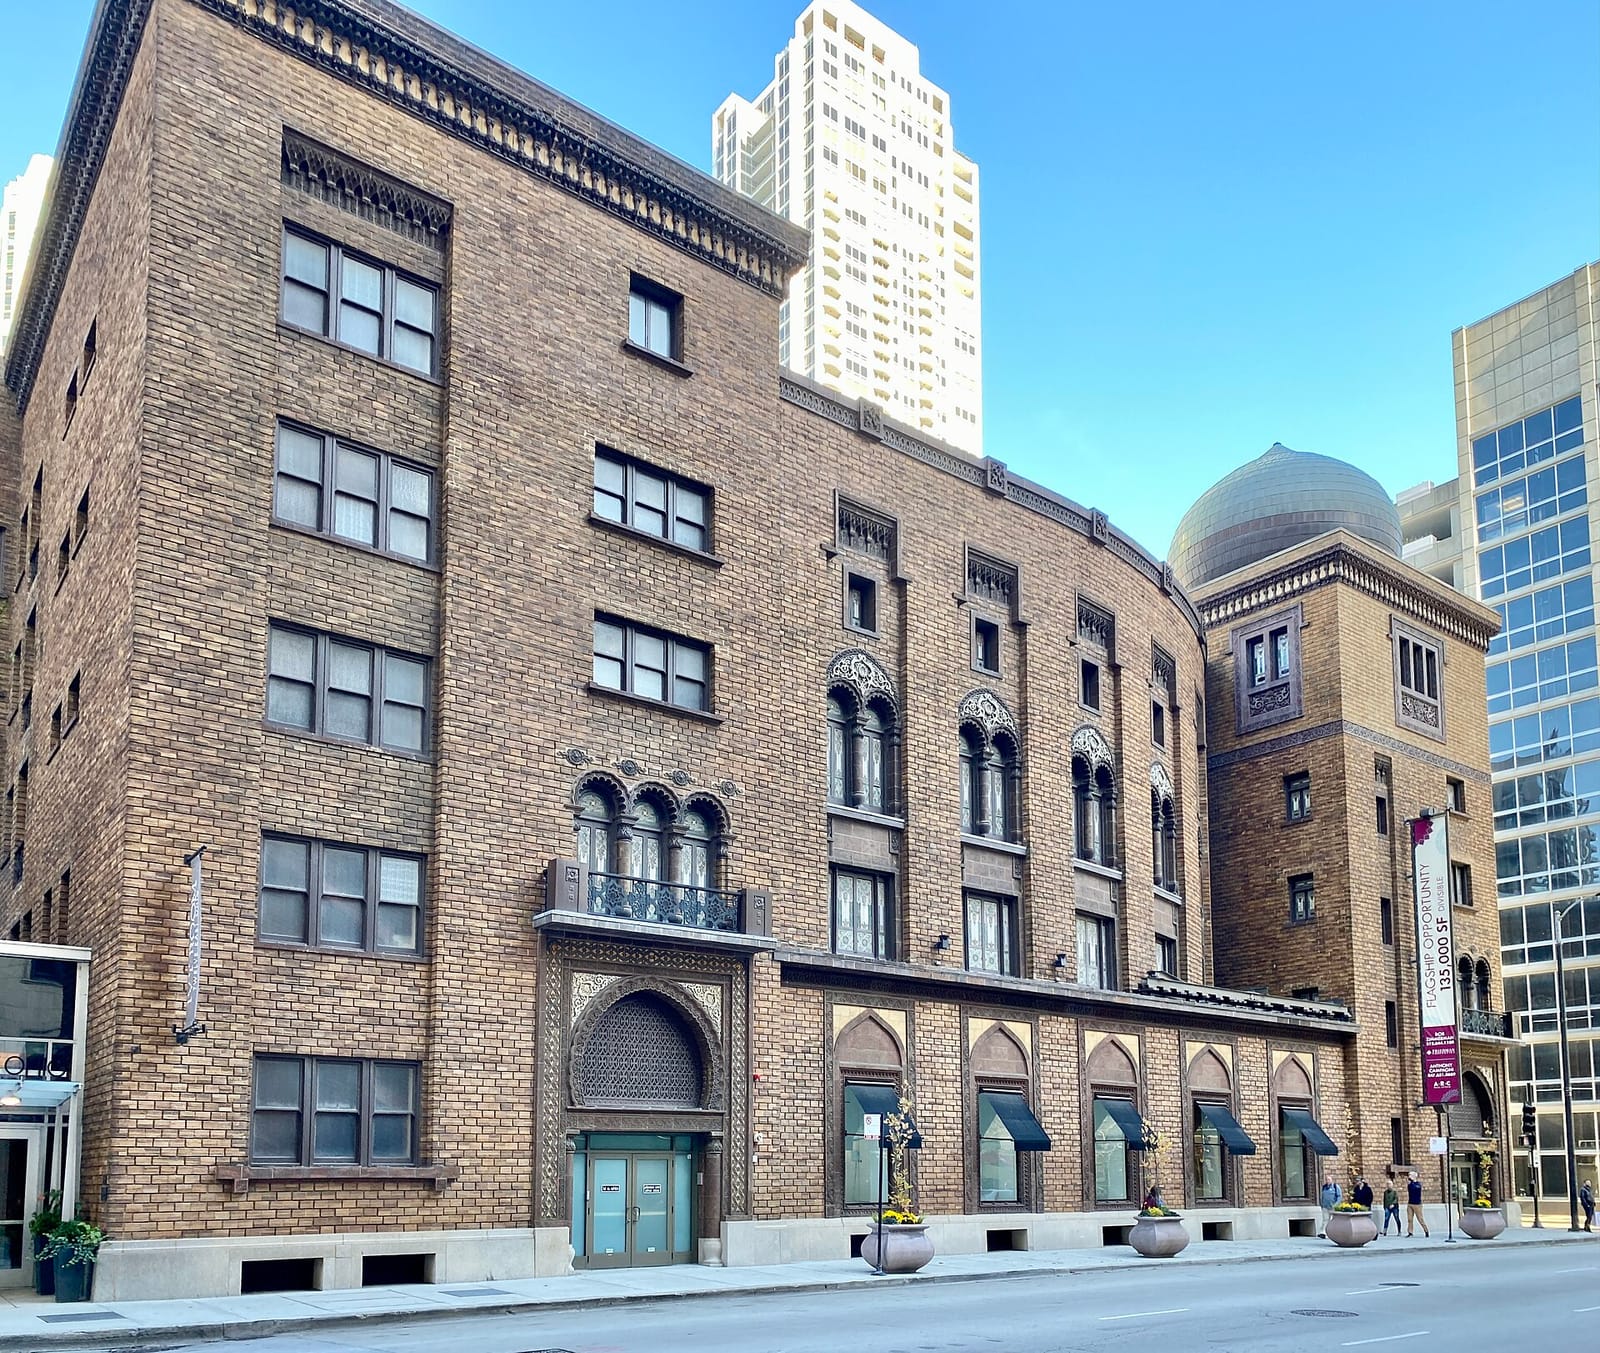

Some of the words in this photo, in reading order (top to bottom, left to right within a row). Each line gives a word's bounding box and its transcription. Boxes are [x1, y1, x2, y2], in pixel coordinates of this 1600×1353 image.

[1420, 864, 1434, 949] OPPORTUNITY
[1436, 876, 1445, 912] DIVISIBLE
[1436, 917, 1448, 932] SF
[1424, 953, 1437, 1008] FLAGSHIP
[1437, 937, 1452, 992] 135,000
